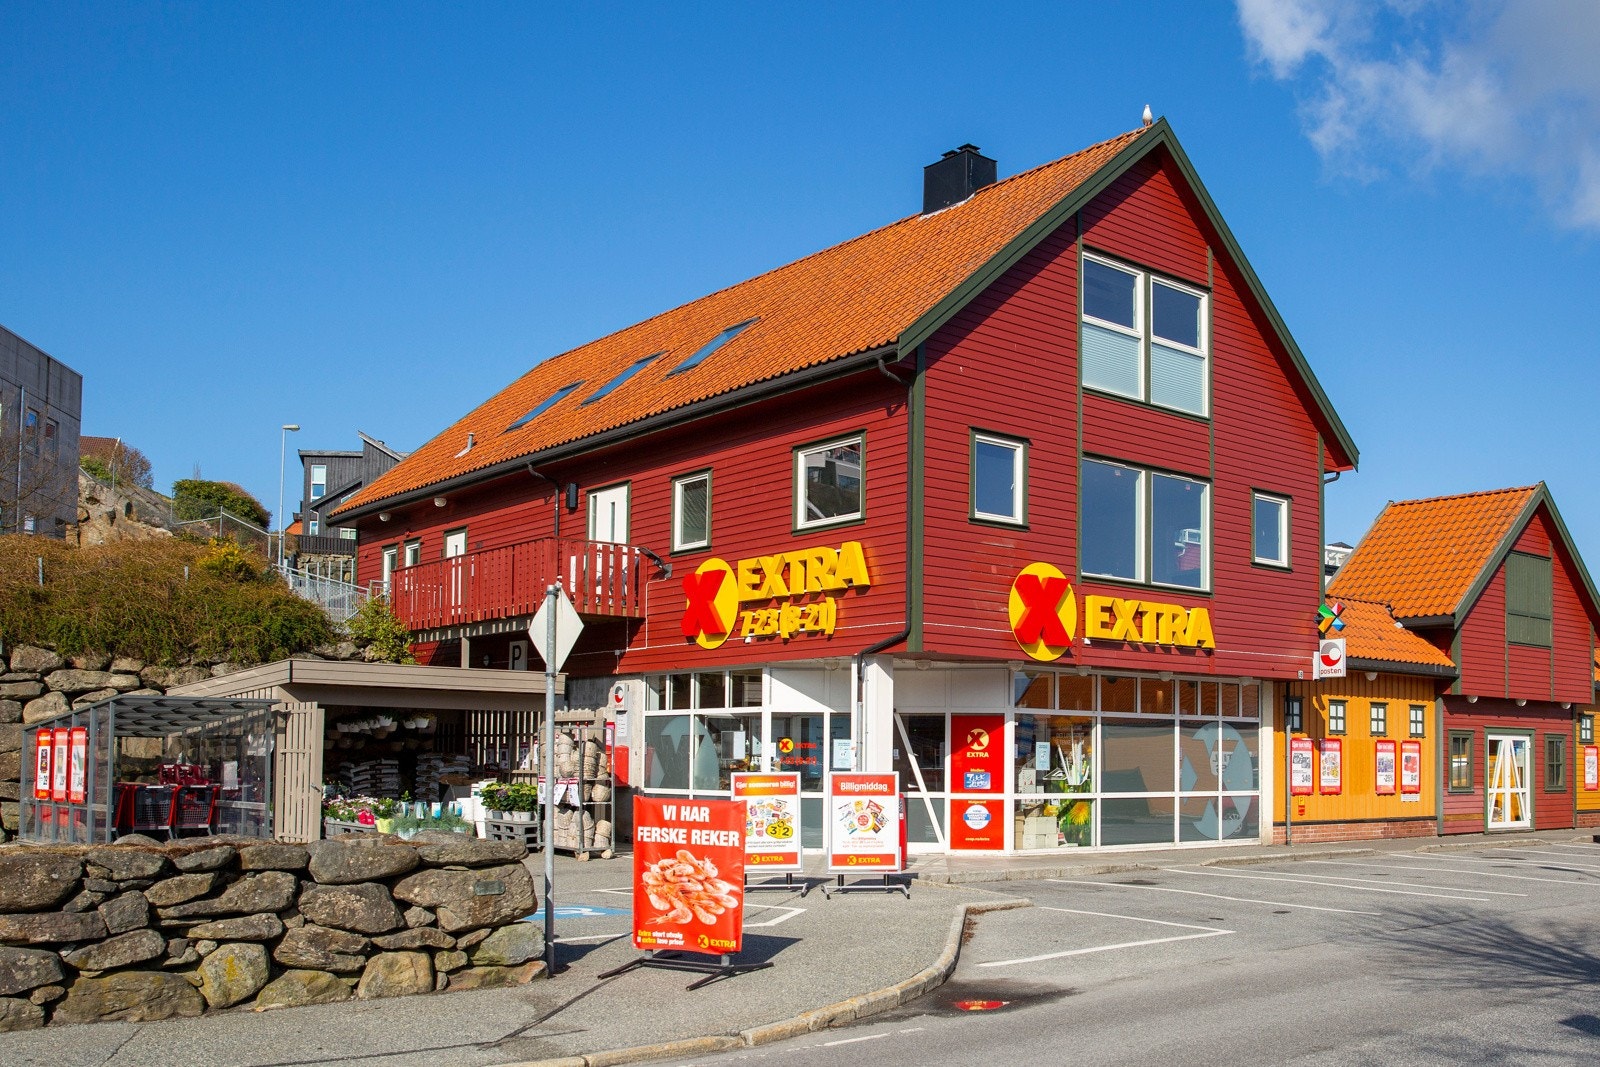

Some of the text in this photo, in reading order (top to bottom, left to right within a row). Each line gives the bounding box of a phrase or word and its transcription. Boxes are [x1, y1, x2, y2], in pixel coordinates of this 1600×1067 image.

[738, 541, 870, 602] EXTRA
[740, 597, 837, 639] 7-23 (8-21)
[1085, 595, 1215, 648] EXTRA
[512, 645, 521, 670] P
[840, 781, 888, 792] Billigmiddag
[662, 805, 710, 822] VI HAR
[637, 826, 740, 847] FERSKE REKER
[710, 939, 737, 948] EXTRA
